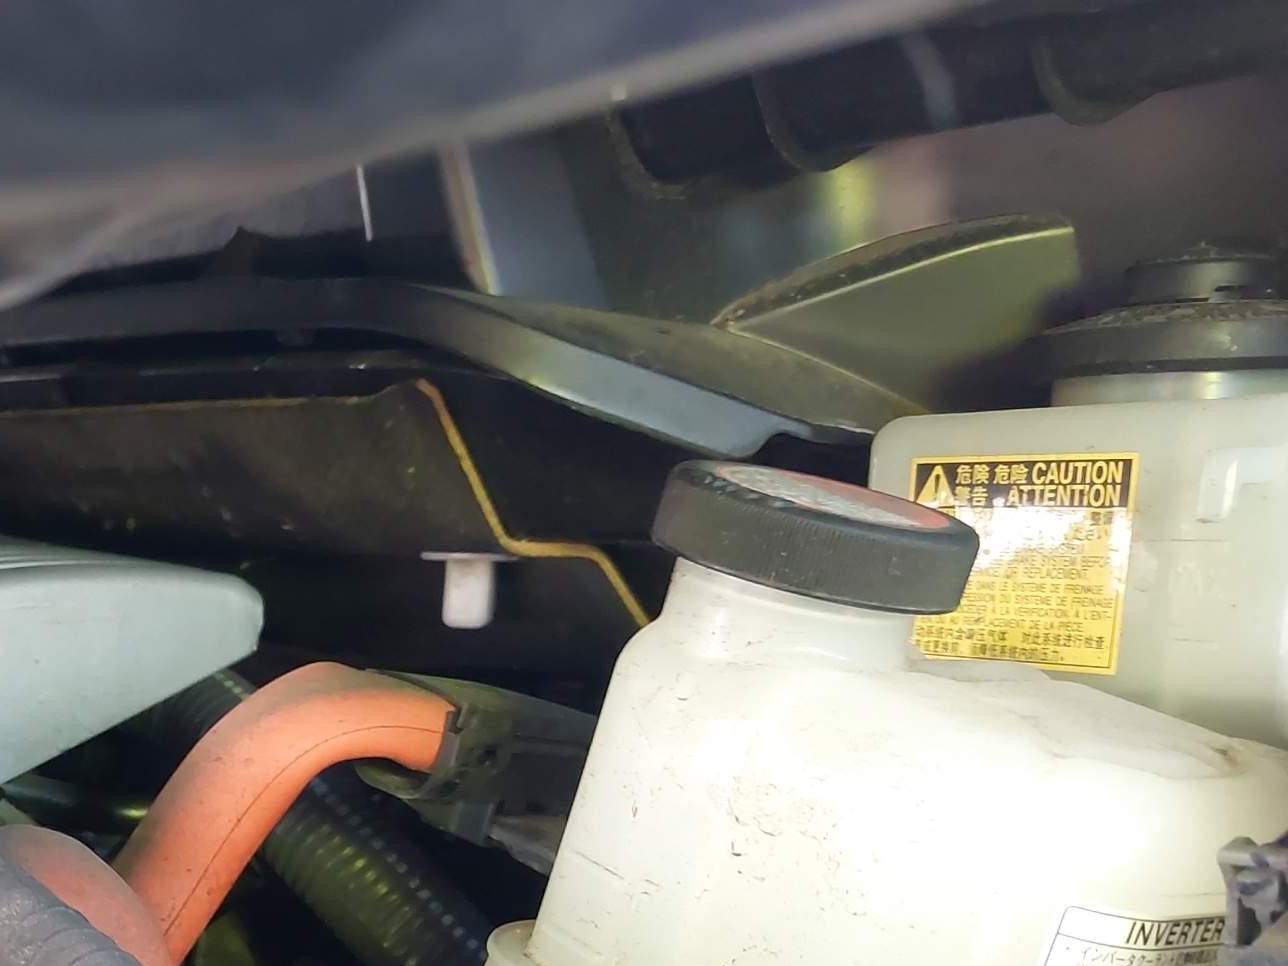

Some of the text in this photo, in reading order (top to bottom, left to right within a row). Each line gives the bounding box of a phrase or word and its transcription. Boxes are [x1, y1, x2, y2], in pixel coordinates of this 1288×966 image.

[1031, 461, 1124, 484] CAUTION
[1007, 484, 1121, 507] ATTENTION
[1126, 920, 1226, 945] INVERTER
